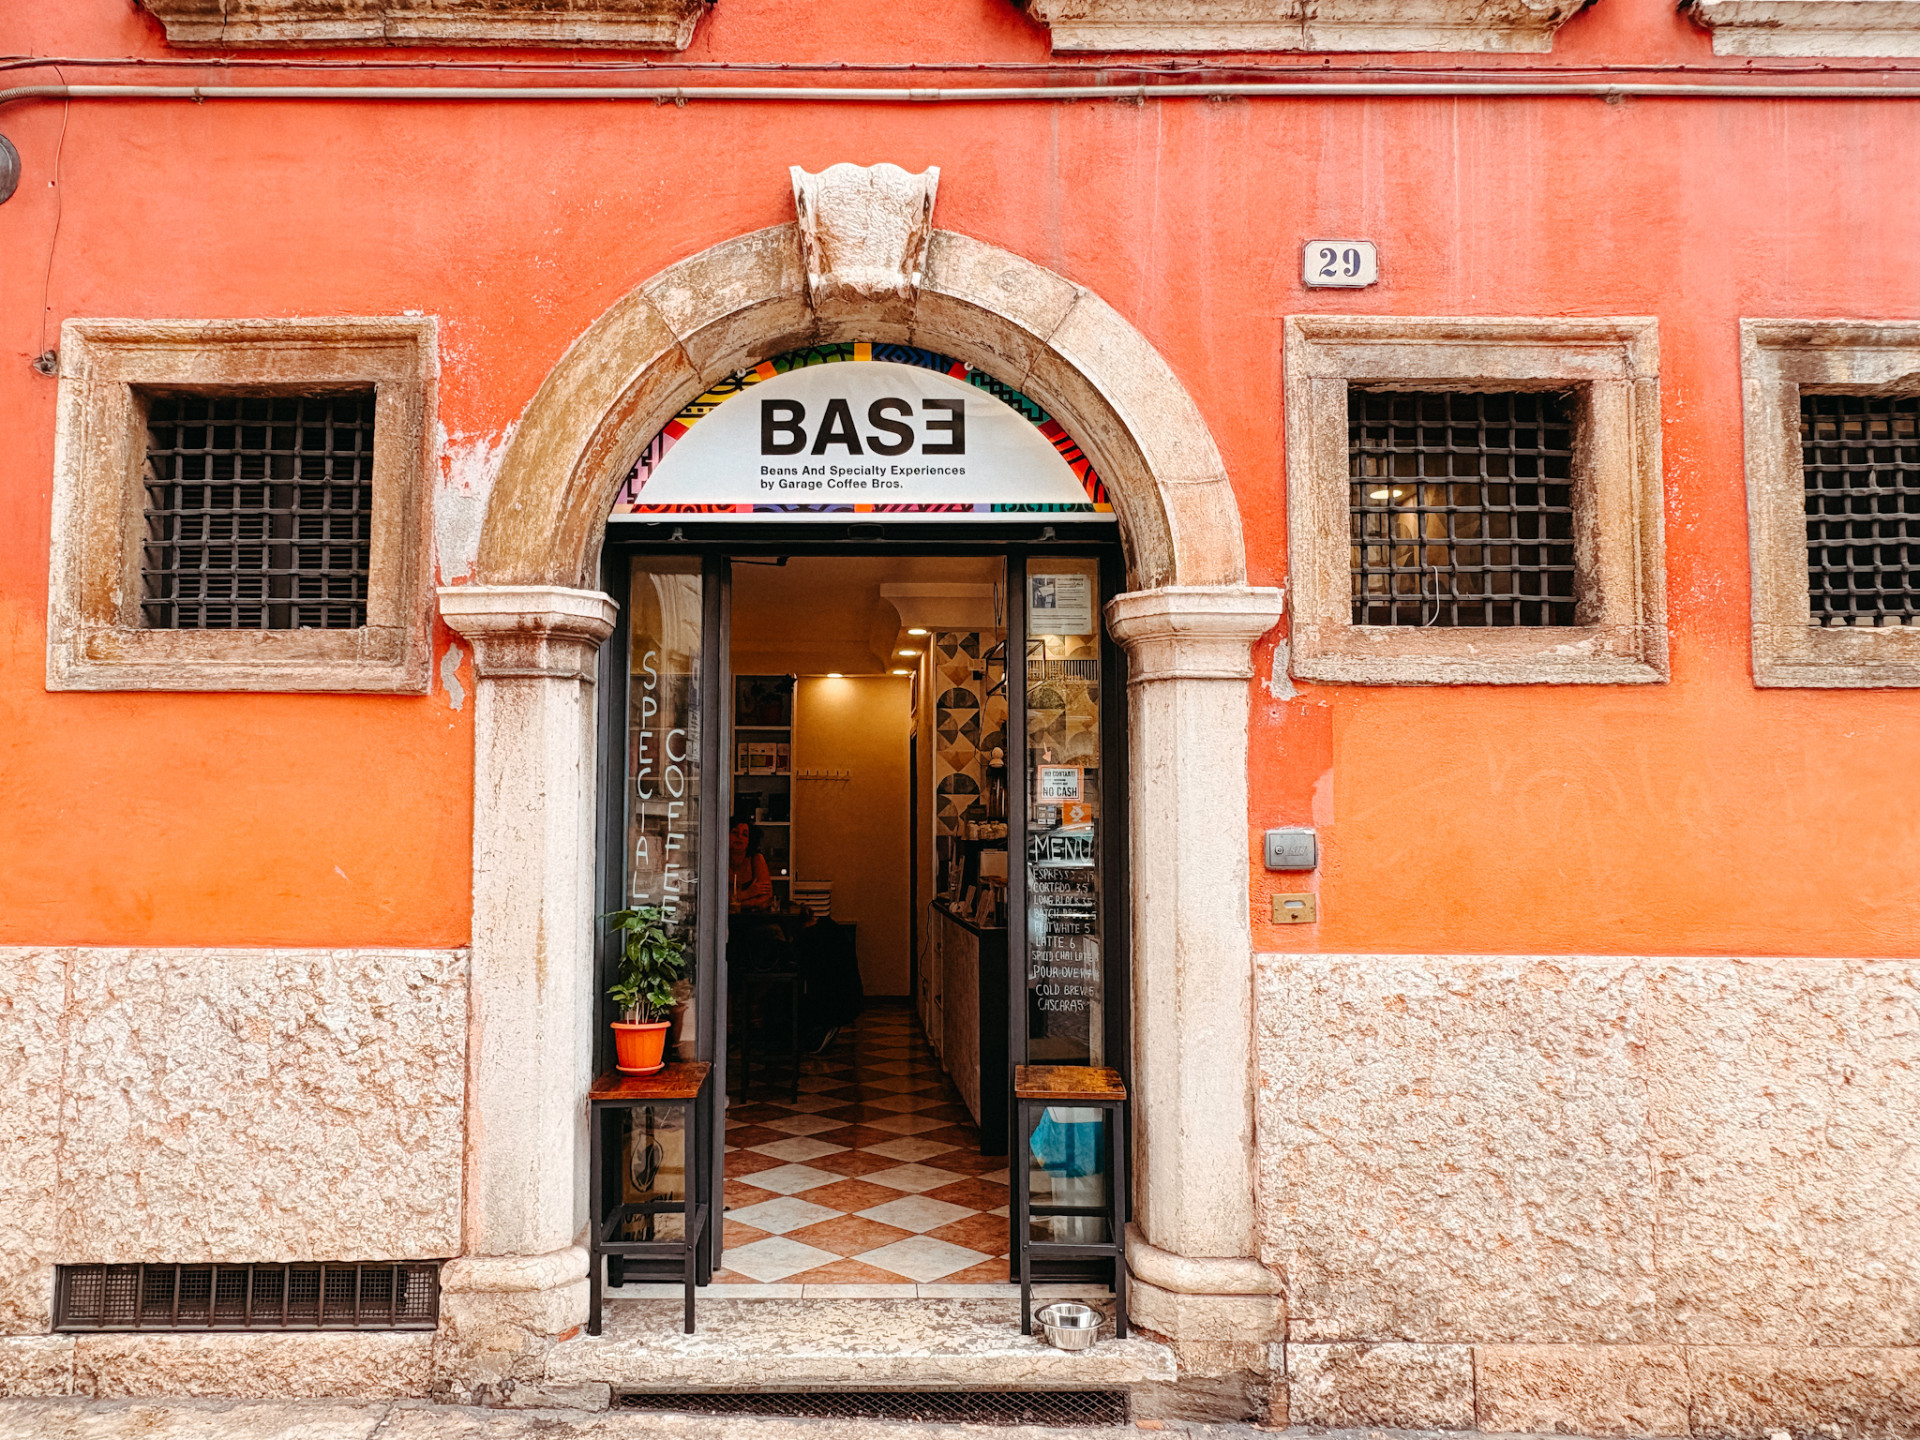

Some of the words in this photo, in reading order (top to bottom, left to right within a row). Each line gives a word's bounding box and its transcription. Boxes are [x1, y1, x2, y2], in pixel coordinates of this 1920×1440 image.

[1319, 247, 1361, 277] 29
[761, 397, 965, 456] BASE
[761, 465, 798, 476] Beans
[802, 465, 825, 476] And
[830, 465, 886, 477] Specialty
[891, 465, 966, 477] Experiences
[761, 479, 774, 490] by
[778, 479, 823, 490] Garage
[827, 479, 867, 489] Coffee
[872, 479, 903, 489] Bros.
[631, 650, 657, 911] SPECIAL
[1043, 786, 1055, 797] NO
[1056, 786, 1078, 797] CASH
[661, 728, 686, 924] COFFEE
[1034, 834, 1092, 863] MENU
[1033, 882, 1071, 893] CORTADO
[1033, 894, 1054, 906] LONG
[1084, 923, 1091, 934] 5
[1035, 935, 1065, 948] LATTE
[1069, 937, 1076, 949] 6
[1055, 950, 1073, 961] CHAI
[1035, 984, 1060, 996] COLD
[1037, 998, 1077, 1012] CASCARA
